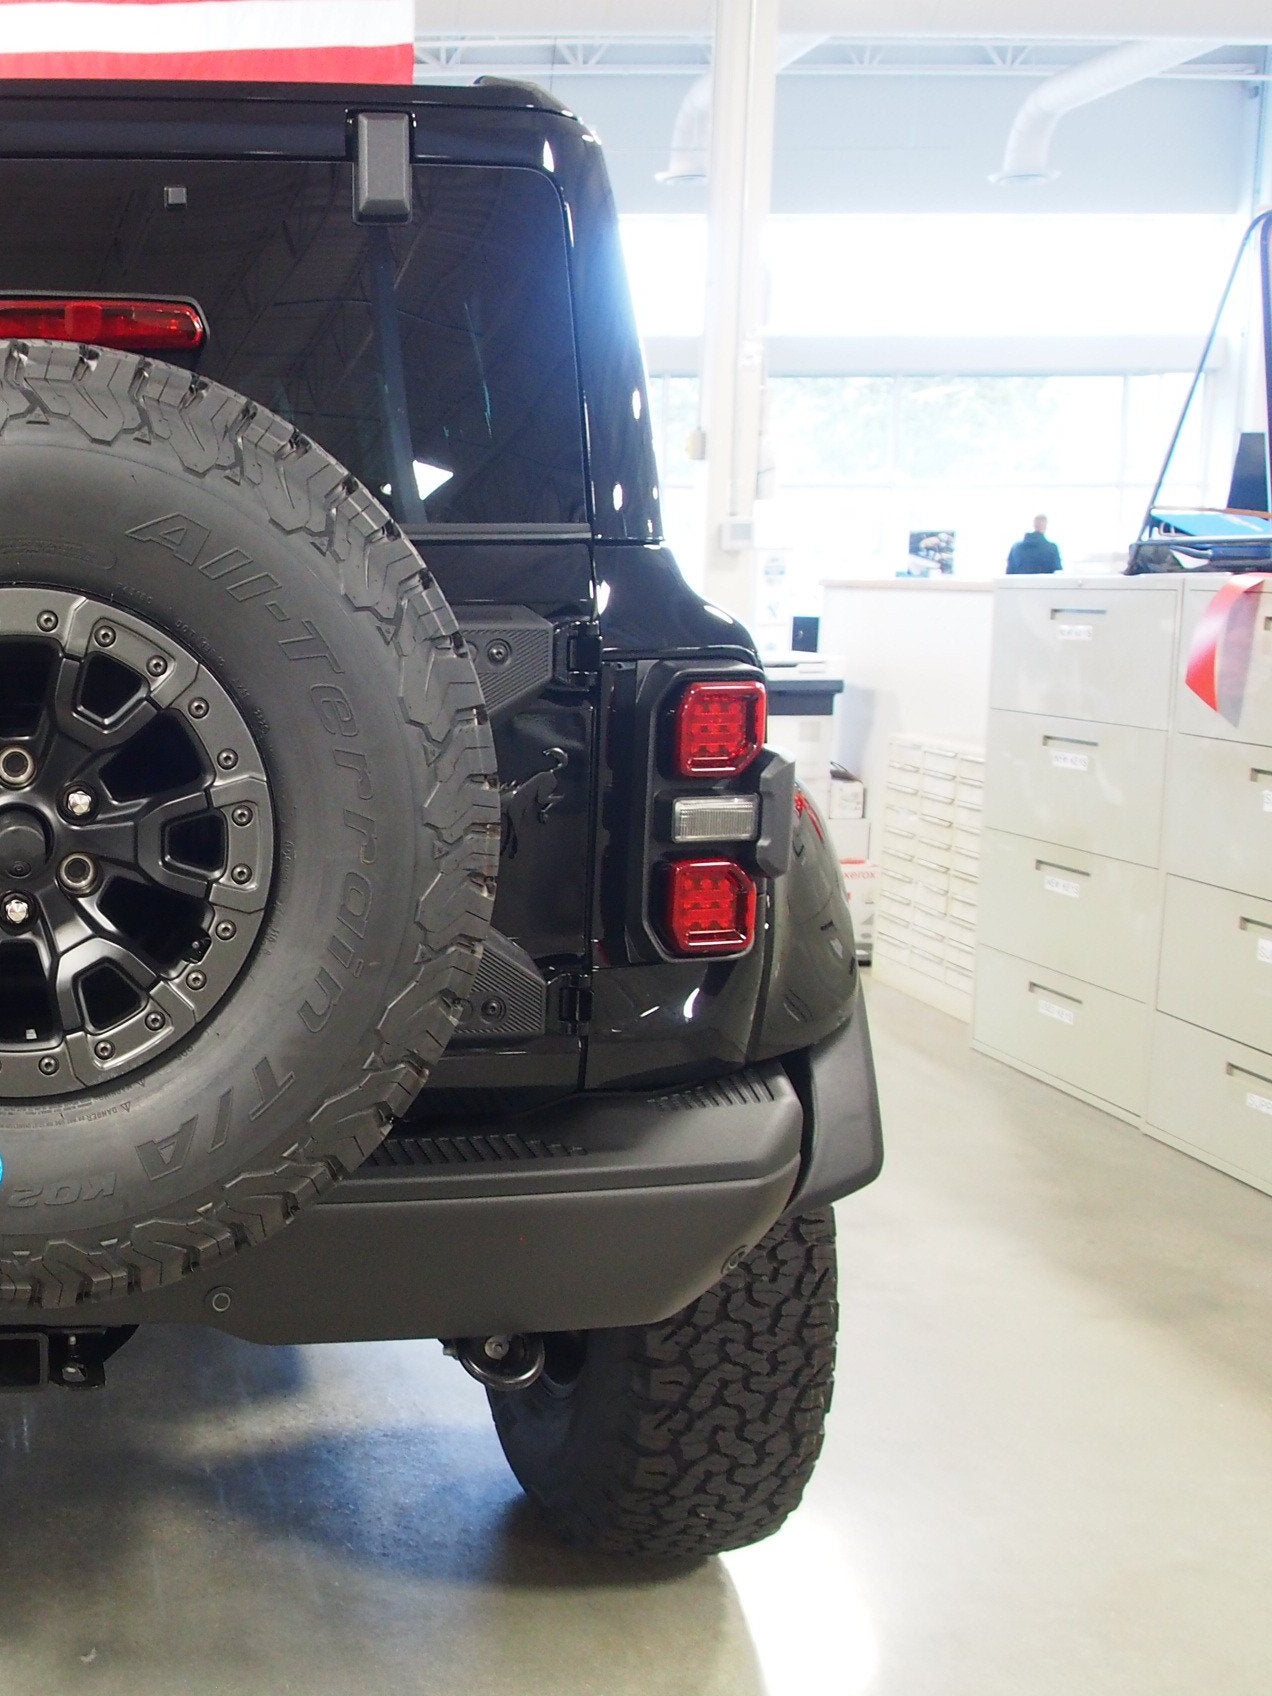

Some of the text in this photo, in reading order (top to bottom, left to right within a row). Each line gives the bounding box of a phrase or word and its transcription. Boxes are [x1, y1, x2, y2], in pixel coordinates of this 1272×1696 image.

[127, 513, 374, 1034] All-Terrain
[843, 871, 876, 880] xerox
[135, 1056, 295, 1181] T/A
[11, 1172, 118, 1208] KO2
